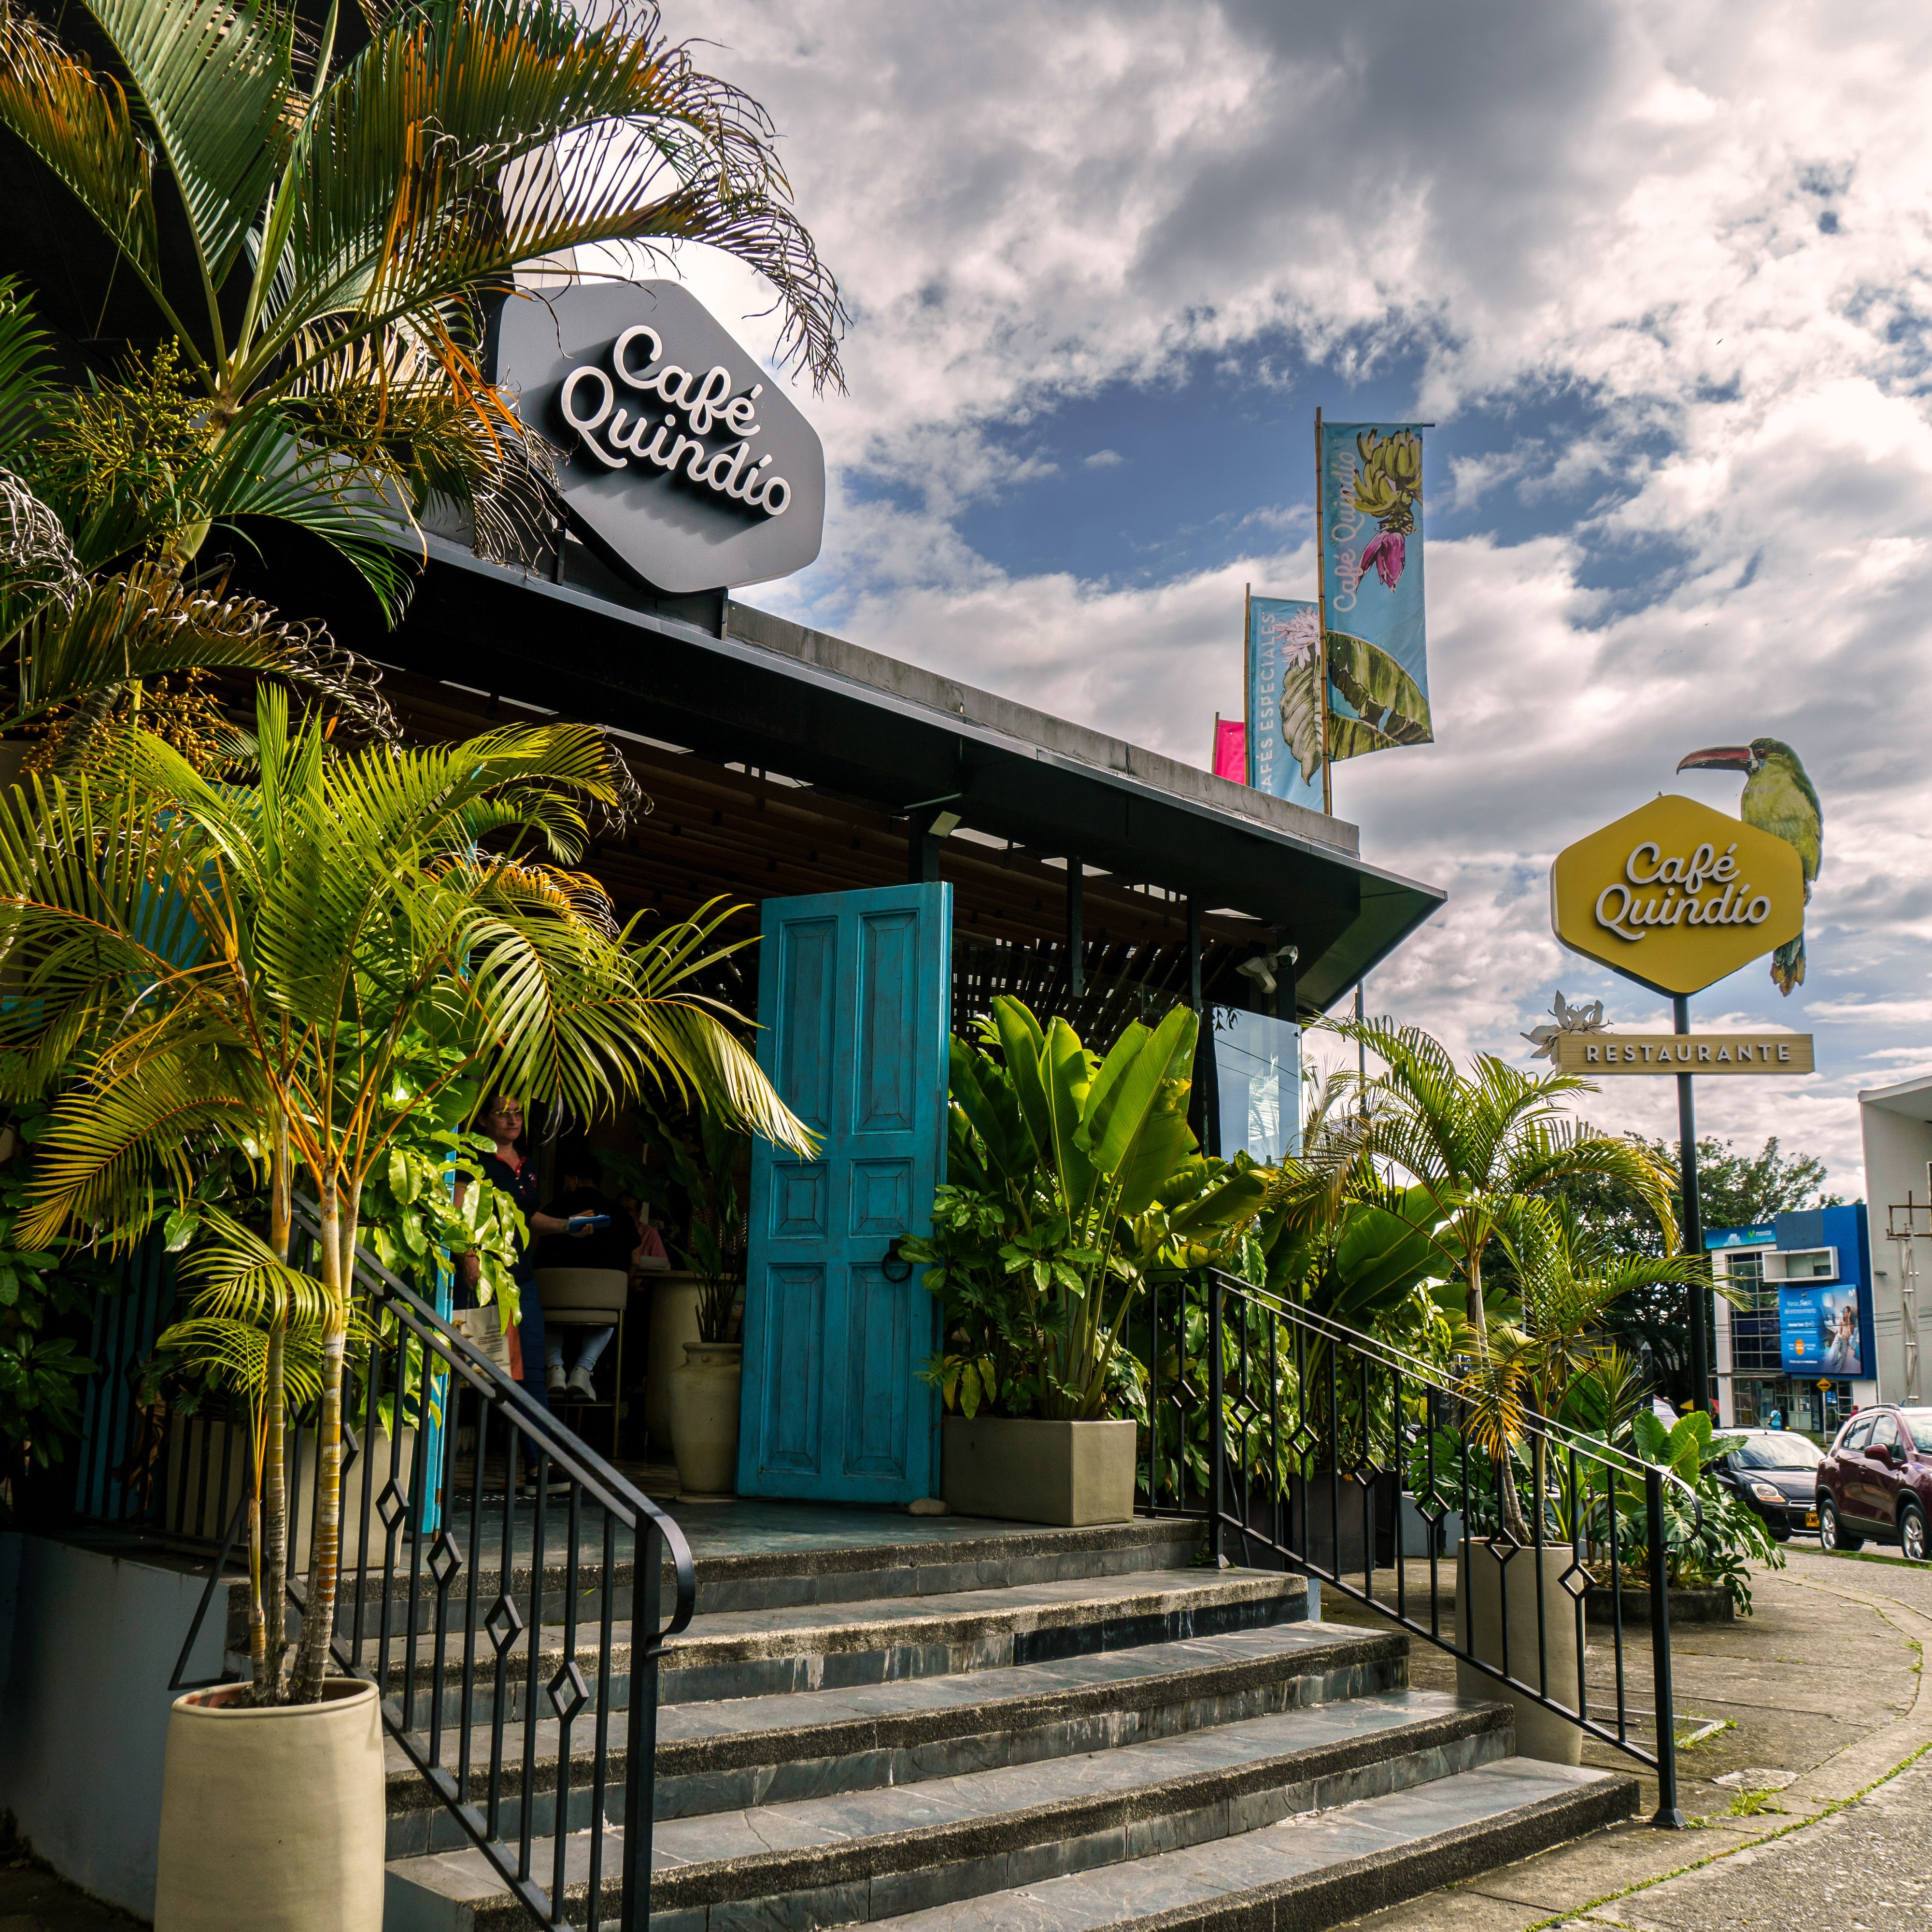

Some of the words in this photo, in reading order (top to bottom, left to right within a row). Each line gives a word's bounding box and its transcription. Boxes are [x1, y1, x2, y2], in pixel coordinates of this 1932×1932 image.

[613, 325, 763, 436] Café
[561, 366, 791, 515] Quindío
[1331, 452, 1365, 542] Quindío
[1333, 548, 1364, 612] Café
[1260, 614, 1276, 731] ESPECIALES
[1256, 738, 1273, 795] AFÉS
[1626, 841, 1740, 894] Café
[1596, 884, 1771, 940] Quindío
[1586, 1044, 1791, 1062] RESTAURANTE
